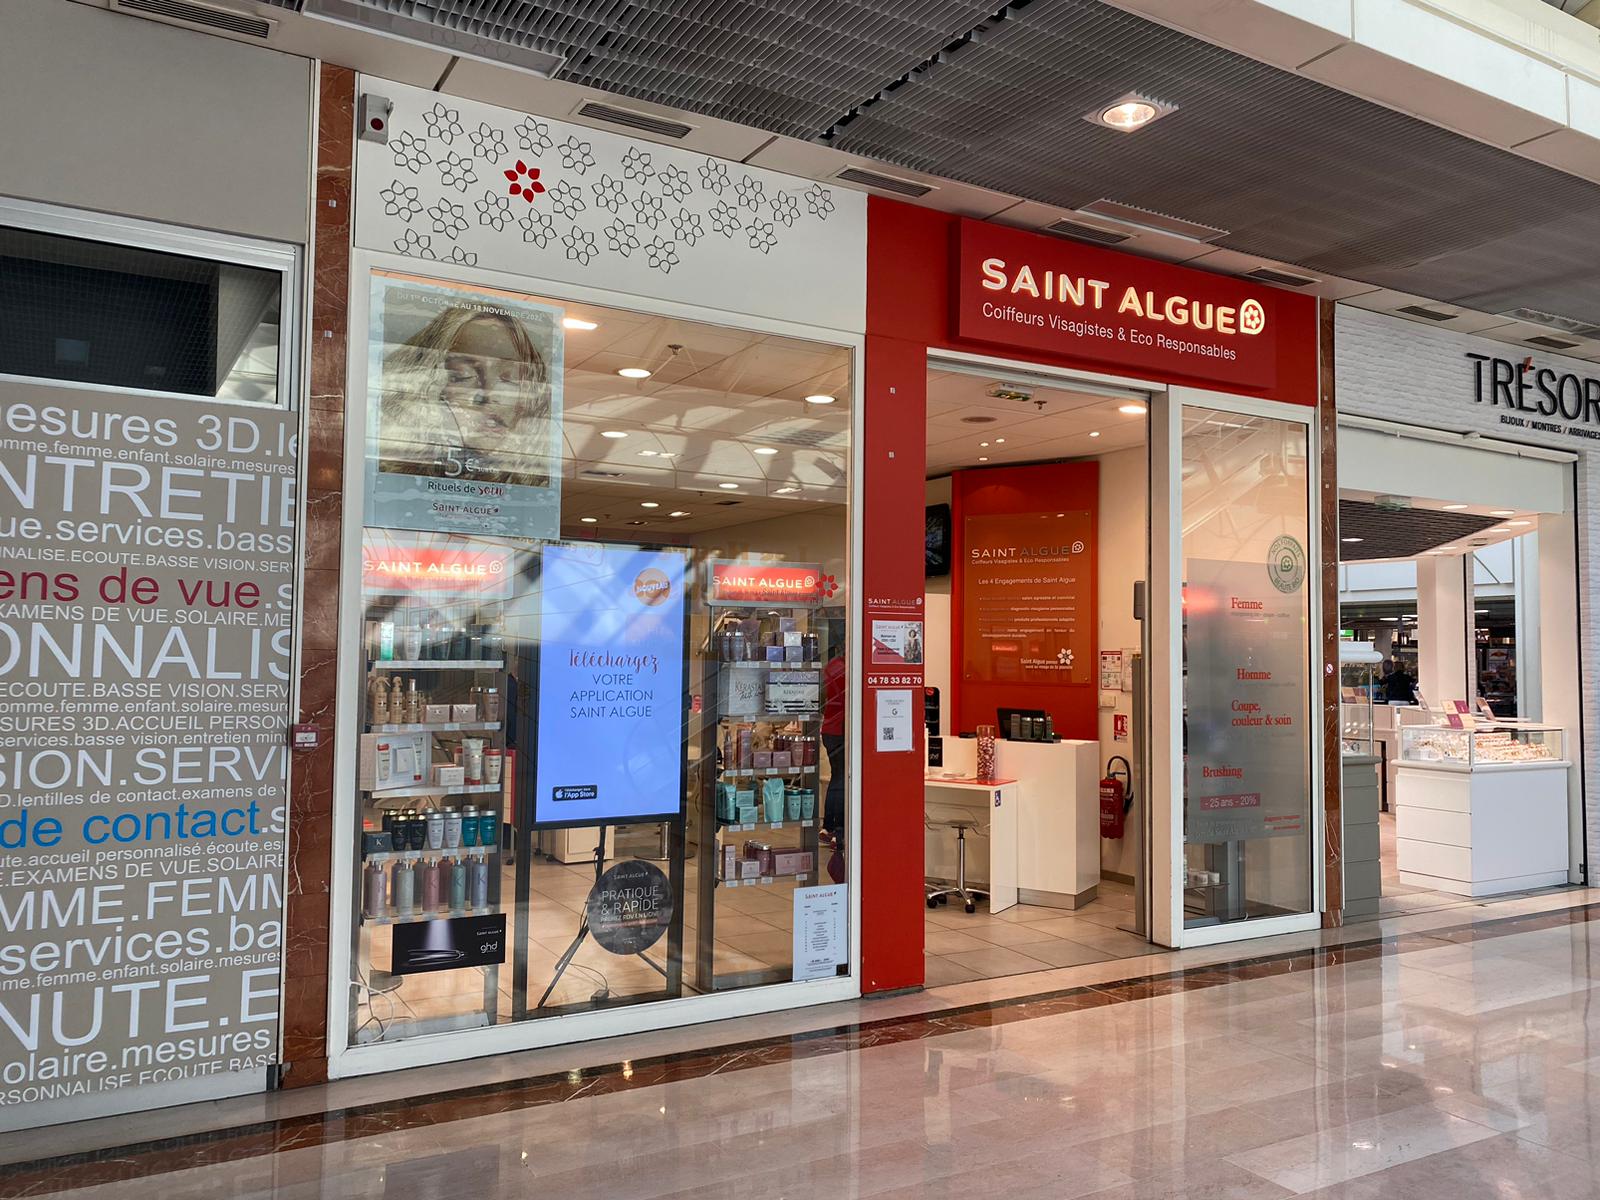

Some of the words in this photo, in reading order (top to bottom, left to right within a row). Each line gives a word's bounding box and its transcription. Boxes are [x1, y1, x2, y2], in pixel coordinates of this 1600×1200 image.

[981, 258, 1110, 309] SAINT
[1118, 286, 1236, 334] ALGUE
[982, 302, 1044, 326] Coiffeurs
[1049, 315, 1113, 339] Visagistes
[1117, 327, 1126, 341] &
[1131, 330, 1153, 346] Eco
[1157, 334, 1236, 360] Responsables
[0, 401, 178, 446] esures
[1500, 415, 1524, 427] BIJOUX
[1532, 421, 1562, 434] MONTRES
[0, 439, 295, 475] mme.femme.enfant.solaire.mesures
[427, 481, 461, 493] Rituels
[464, 484, 476, 493] de
[463, 506, 491, 515] ALGUE
[971, 548, 1016, 558] SAINT
[1021, 546, 1070, 555] ALGUE
[363, 560, 422, 573] SAINT
[427, 562, 489, 576] ALGUE
[99, 567, 160, 605] de
[712, 575, 757, 587] SAINT
[759, 577, 803, 589] ALGUE
[1231, 597, 1263, 610] Femme
[92, 606, 120, 621] DE
[569, 649, 659, 674] Téléchargez
[592, 673, 633, 686] VOTRE
[868, 676, 877, 685] 04
[880, 676, 889, 685] 78
[890, 676, 900, 685] 33
[902, 676, 911, 685] 82
[912, 676, 922, 685] 70
[1237, 668, 1271, 680] Homme
[570, 690, 653, 702] APPLICATION
[570, 706, 607, 719] SAINT
[609, 705, 652, 718] ALGUE
[1232, 699, 1261, 714] Coupe,
[83, 716, 203, 732] 3D.ACCUEIL
[210, 715, 288, 731] PERSON
[1232, 714, 1264, 727] couleur
[1265, 714, 1273, 725] &
[1275, 713, 1292, 725] soin
[131, 731, 250, 746] vision.entretien
[0, 745, 286, 790] ION.SERVI
[1203, 766, 1242, 779] Brushing
[90, 790, 111, 804] de
[116, 785, 253, 803] contact.examens
[258, 784, 276, 798] de
[580, 790, 595, 798] Store
[0, 808, 63, 849] de
[96, 839, 283, 868] personnalisé.écoute.es
[124, 861, 154, 879] DE
[602, 885, 659, 901] PRATIQUE
[601, 903, 610, 916] &
[613, 898, 659, 915] RAPIDE
[480, 941, 498, 954] ghd
[3, 1028, 271, 1085] olaire.mesures
